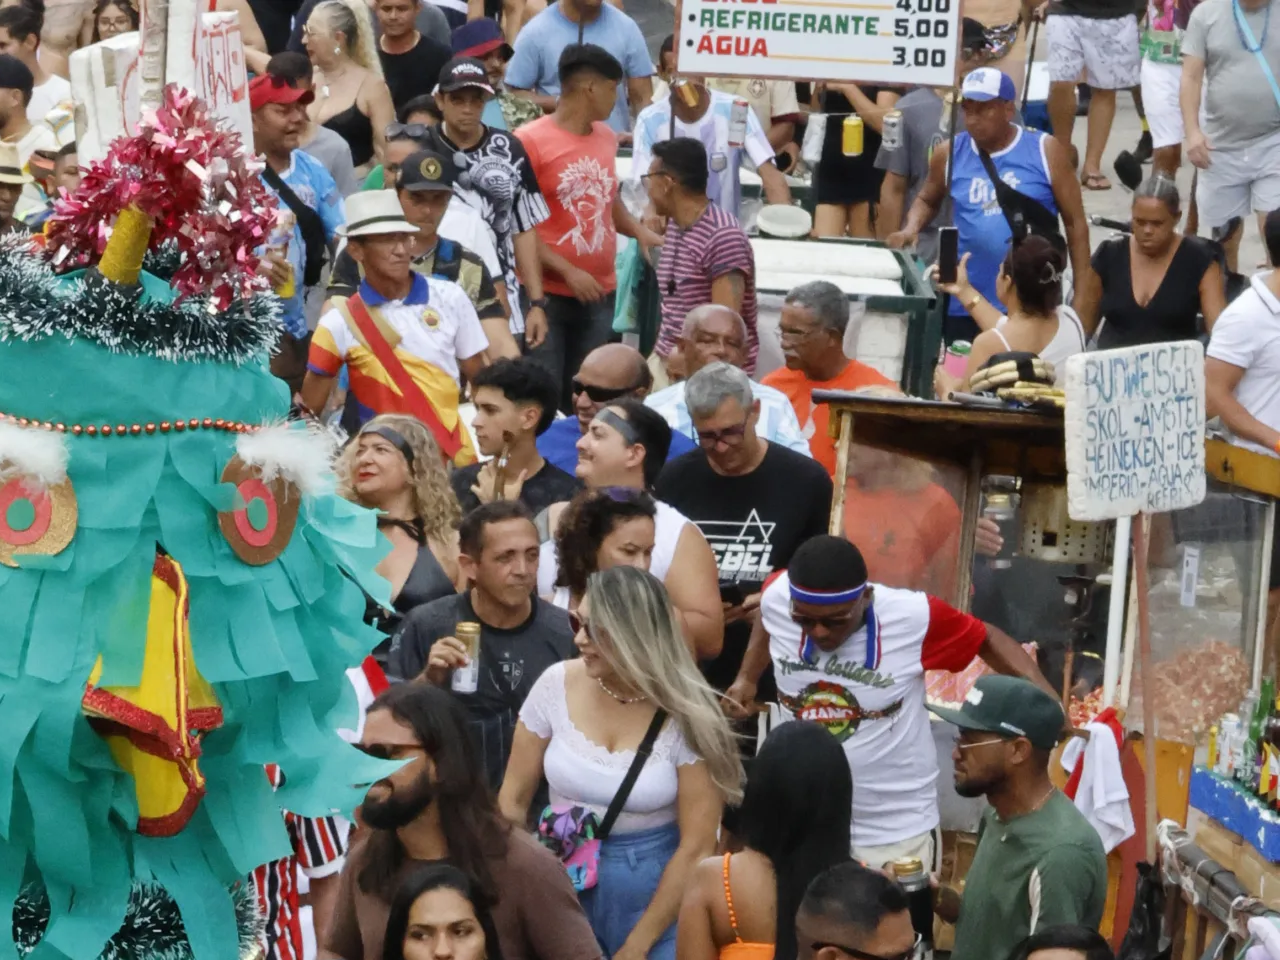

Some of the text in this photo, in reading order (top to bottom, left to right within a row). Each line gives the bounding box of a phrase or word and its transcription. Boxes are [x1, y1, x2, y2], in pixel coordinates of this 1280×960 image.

[700, 8, 949, 39] REFRIGERANTE 5,00
[895, 0, 950, 15] 4,00
[696, 29, 947, 68] ÁGUA 3,00
[1085, 347, 1197, 408] BUDWEISER
[1086, 403, 1128, 442] SKOL
[709, 543, 775, 573] EBEL
